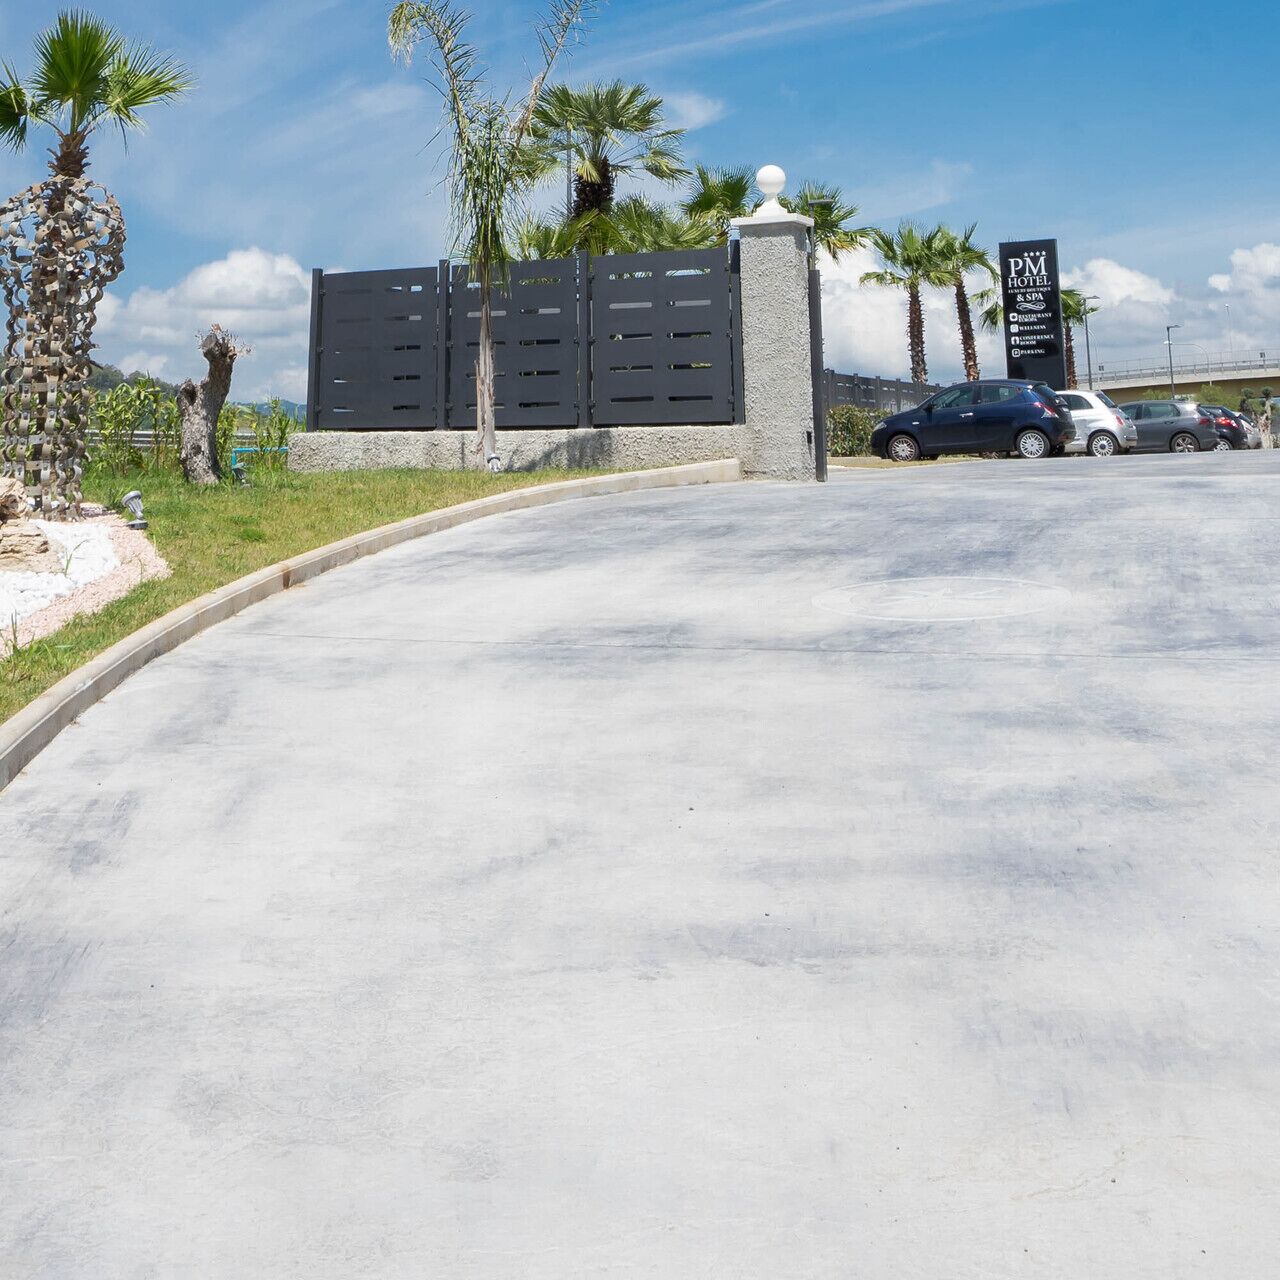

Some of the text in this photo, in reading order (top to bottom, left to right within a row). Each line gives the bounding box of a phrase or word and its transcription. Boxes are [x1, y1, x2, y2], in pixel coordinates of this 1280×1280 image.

[1008, 256, 1048, 277] PM
[1008, 276, 1051, 287] HOTEL
[1025, 293, 1044, 301] SPA
